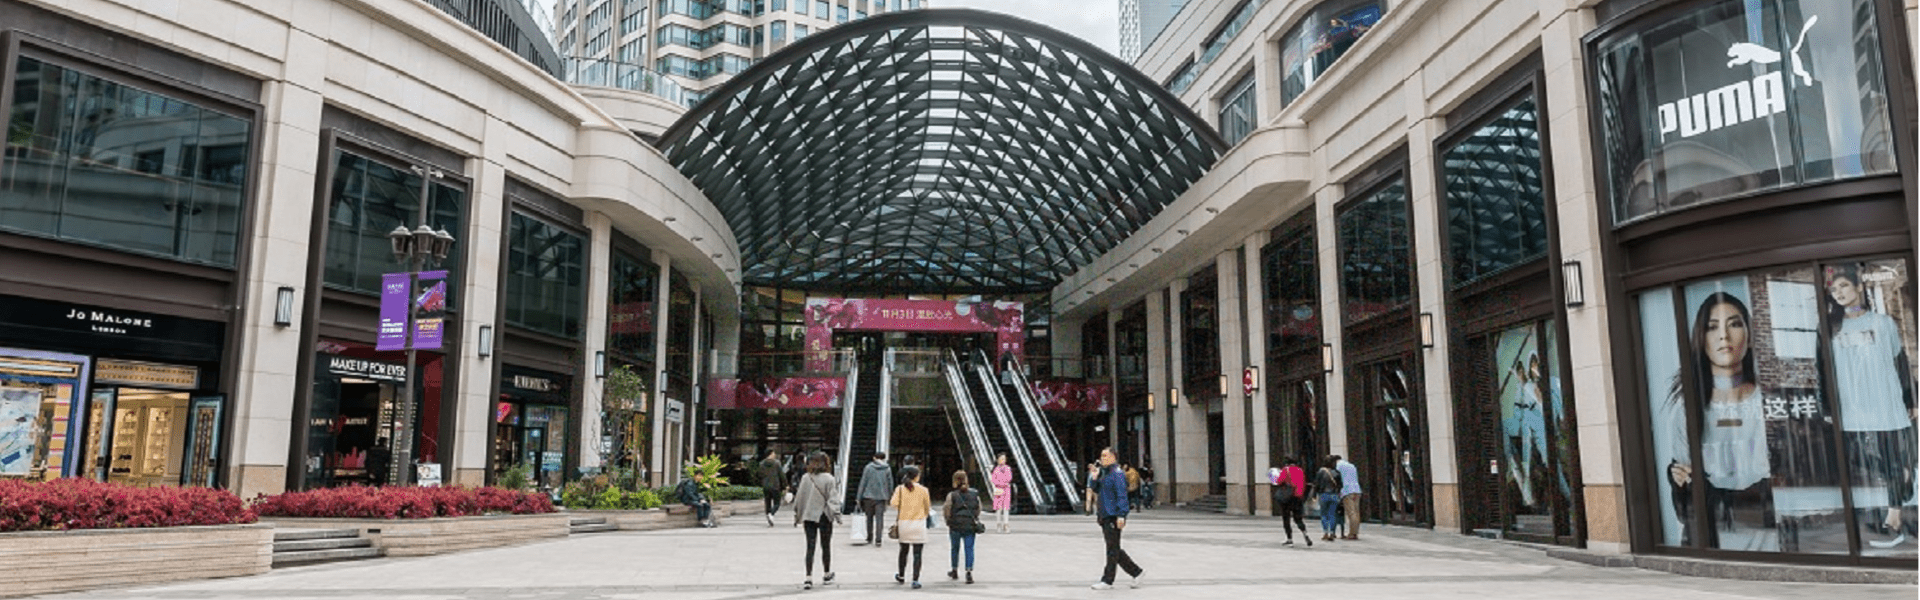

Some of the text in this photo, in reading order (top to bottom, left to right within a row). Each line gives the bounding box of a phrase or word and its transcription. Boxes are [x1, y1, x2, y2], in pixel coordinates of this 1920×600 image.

[1658, 71, 1787, 143] PUMA
[90, 311, 152, 328] MALONE
[329, 357, 407, 377] MAKE UP FOR EVER
[1763, 394, 1818, 419] 这样
